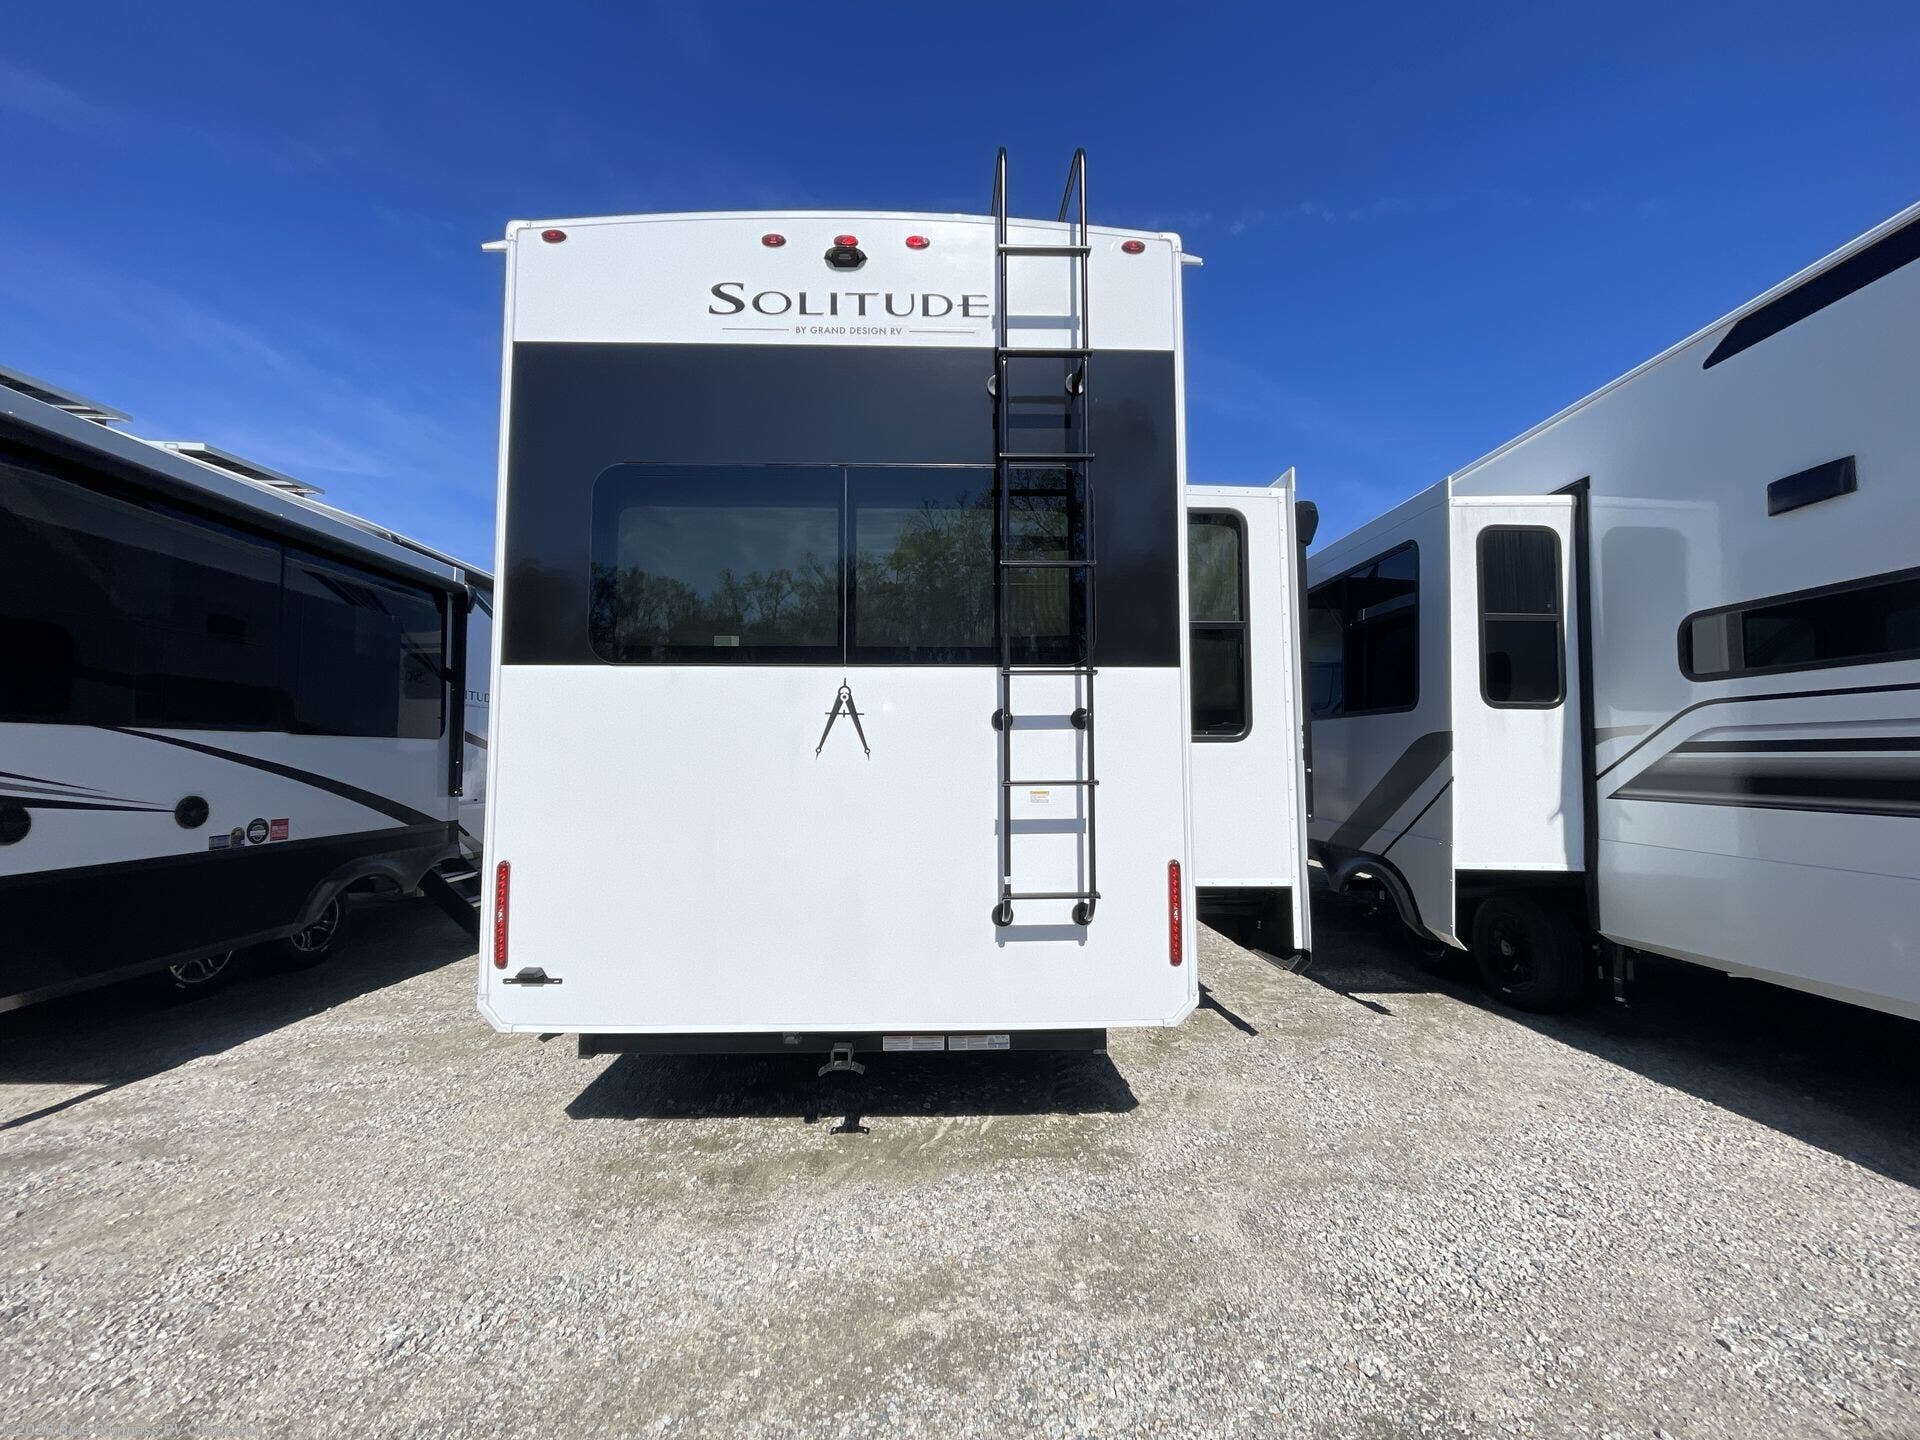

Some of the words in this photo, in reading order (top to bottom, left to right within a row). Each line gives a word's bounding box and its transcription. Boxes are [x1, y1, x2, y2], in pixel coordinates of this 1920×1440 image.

[708, 281, 989, 318] SOLITUDE
[795, 325, 806, 334] BY
[810, 326, 847, 335] GRAND
[849, 326, 887, 336] DESIGN
[890, 327, 903, 336] RV
